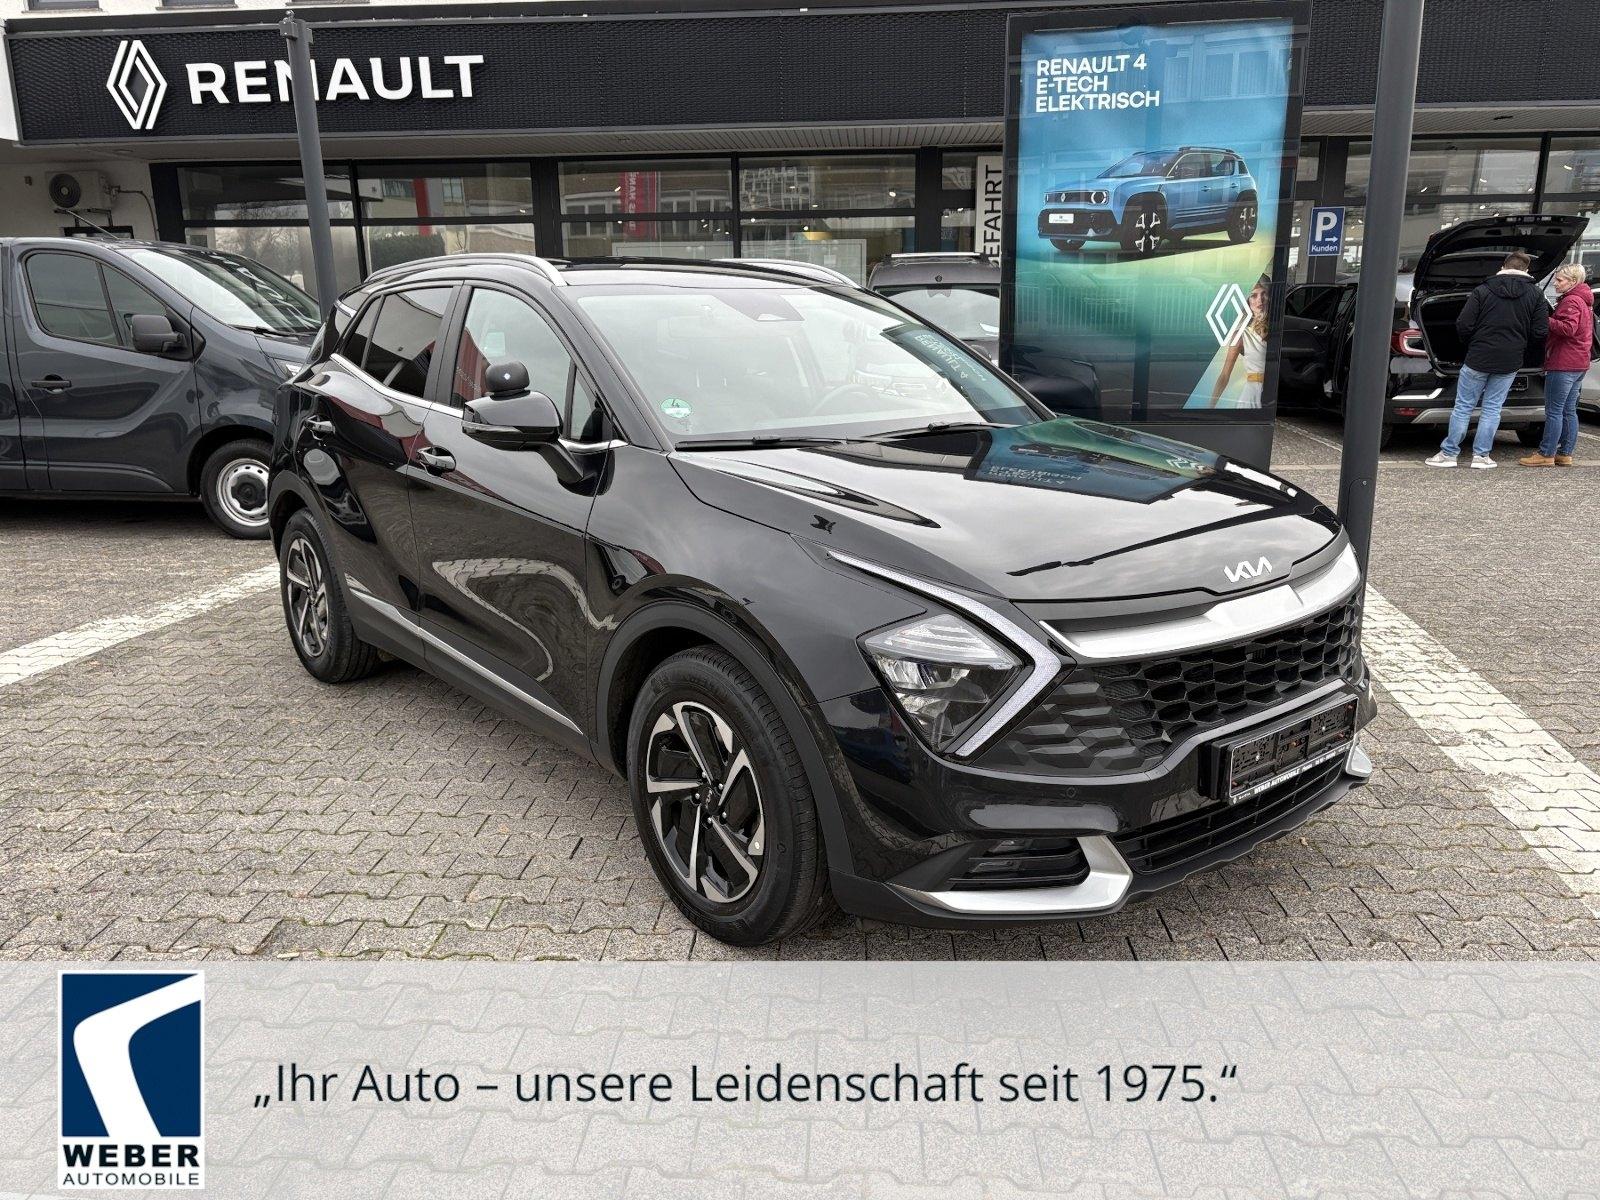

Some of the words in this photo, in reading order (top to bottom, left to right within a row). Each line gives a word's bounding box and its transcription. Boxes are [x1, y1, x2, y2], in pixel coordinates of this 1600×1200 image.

[1037, 55, 1130, 76] RENAULT
[1133, 53, 1147, 70] 4
[1036, 75, 1108, 94] E-TECH
[1036, 90, 1160, 112] ELEKTRISCH
[984, 165, 1002, 267] EFAHRT
[1315, 212, 1337, 241] P
[1311, 244, 1338, 252] Kunden
[1223, 556, 1273, 583] KIA
